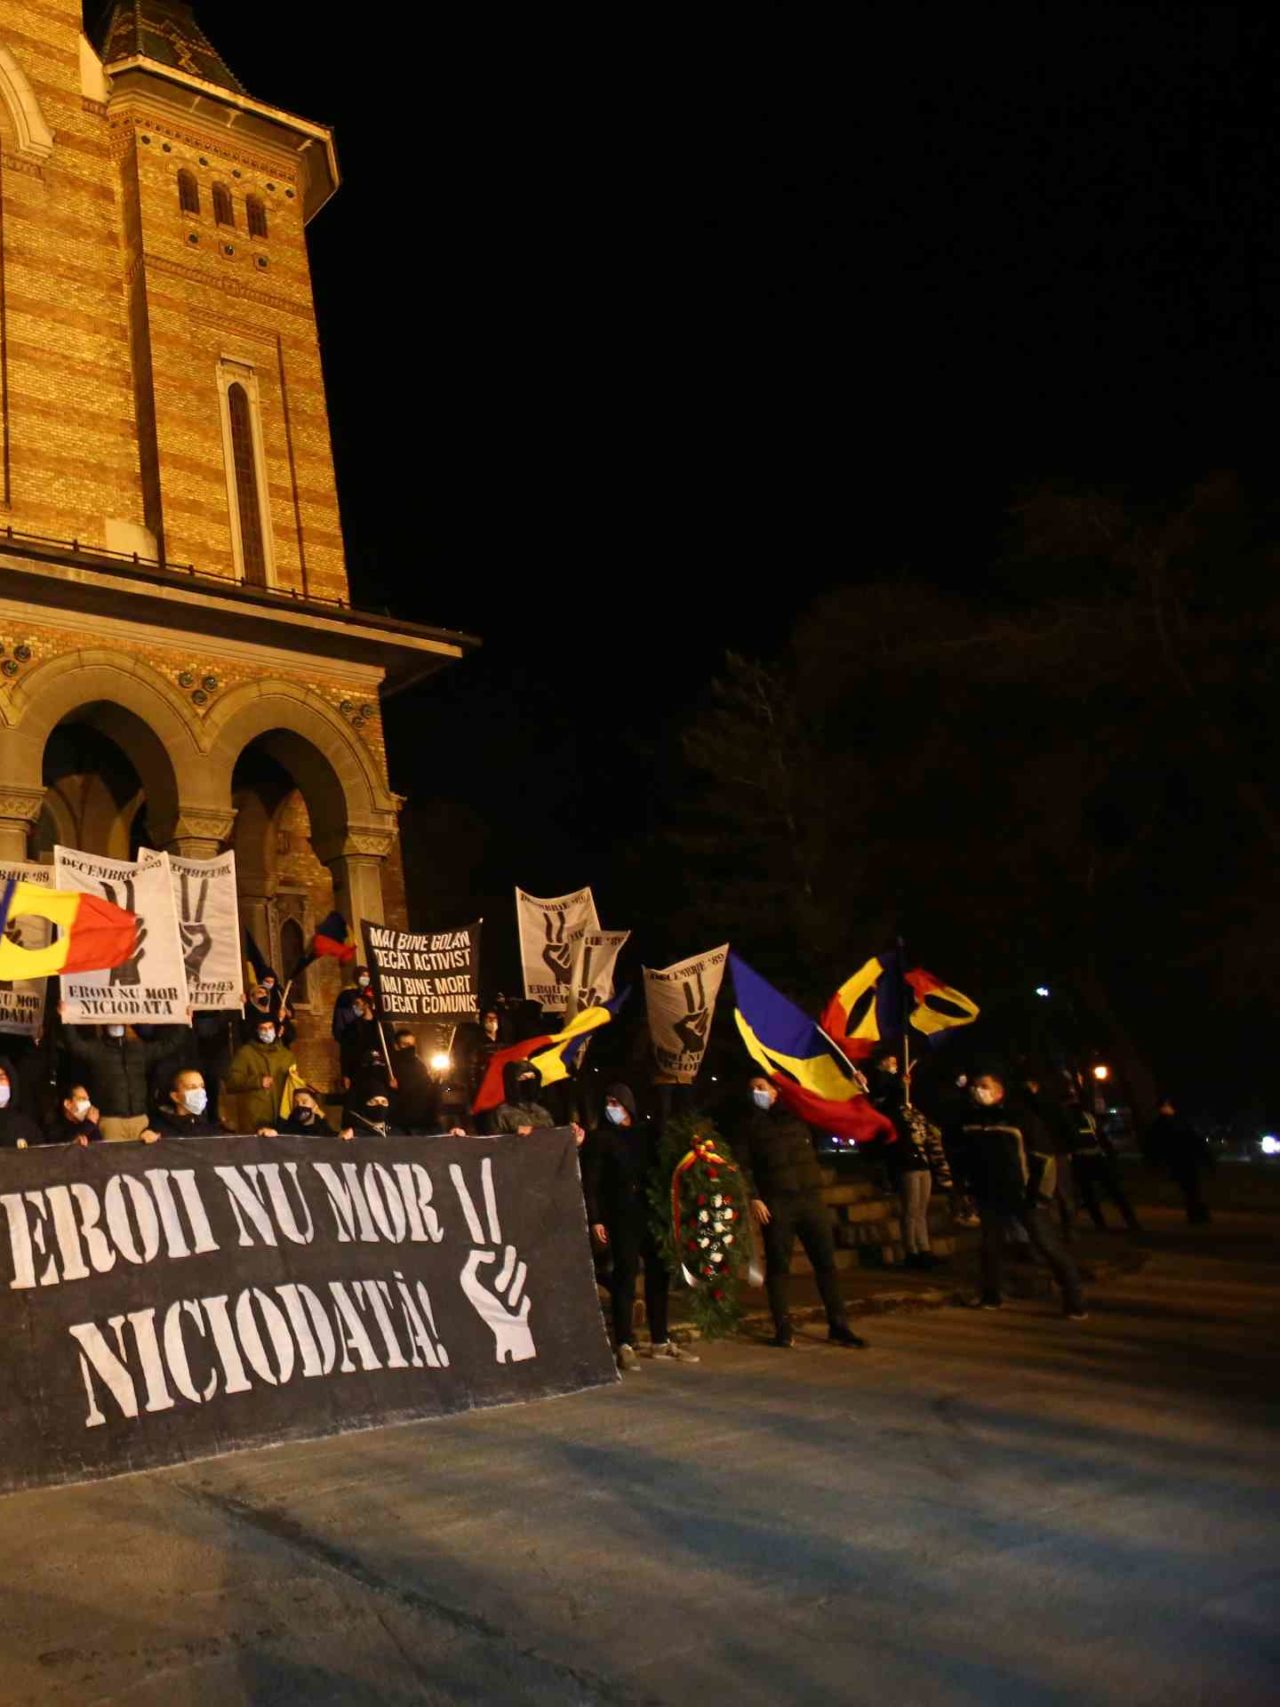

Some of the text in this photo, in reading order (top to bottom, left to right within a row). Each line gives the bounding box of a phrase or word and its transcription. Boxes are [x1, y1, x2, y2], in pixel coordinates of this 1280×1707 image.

[370, 927, 471, 951] MAI BINE GOLAN
[414, 948, 471, 971] ACTIVIST
[69, 985, 179, 1000] EROII NU MOR
[403, 977, 434, 996] BINE
[434, 975, 471, 994] MORT
[80, 1000, 173, 1015] NICIODATA
[382, 994, 477, 1014] DECAT COMUNIS
[0, 1162, 445, 1290] EROII NU MOR
